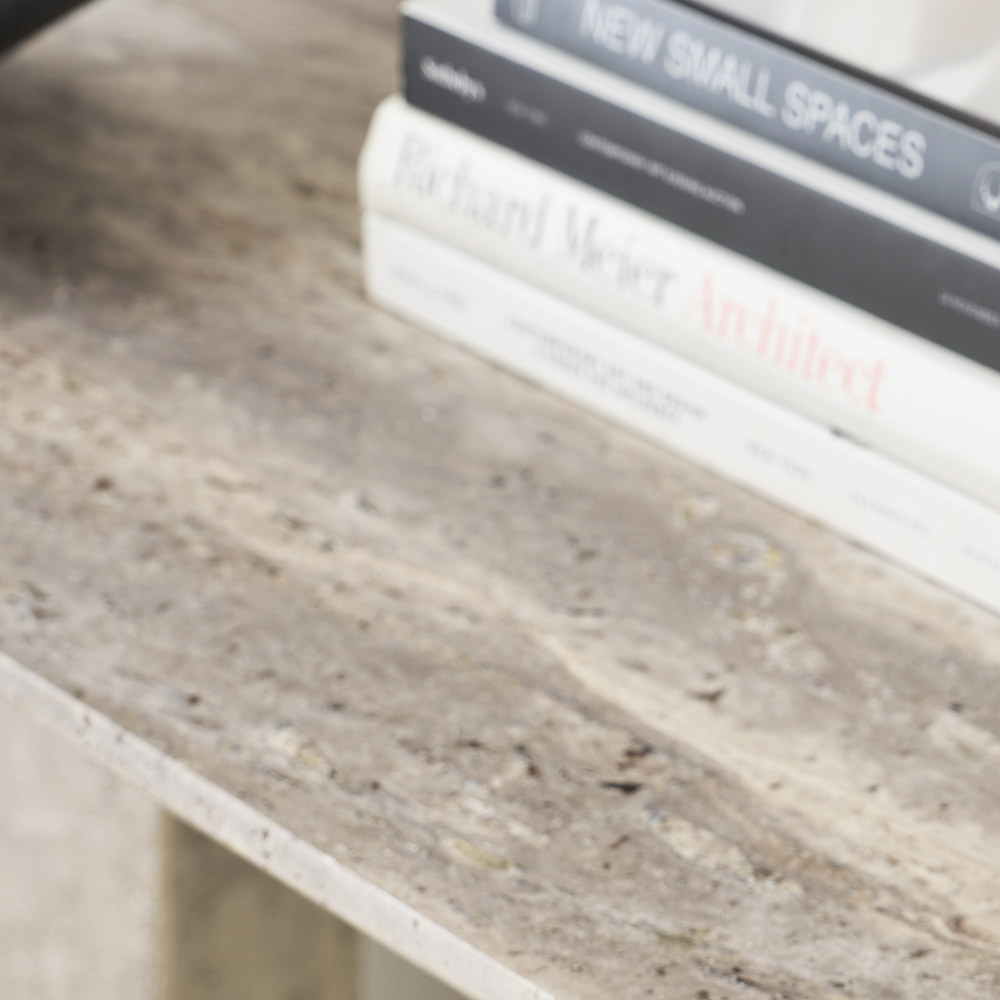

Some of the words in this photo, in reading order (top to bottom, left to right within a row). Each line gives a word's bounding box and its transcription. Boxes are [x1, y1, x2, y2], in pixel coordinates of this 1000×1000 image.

[579, 0, 666, 65] NEW
[664, 31, 776, 118] SMALL
[781, 80, 927, 180] SPACES
[683, 268, 885, 415] Architect
